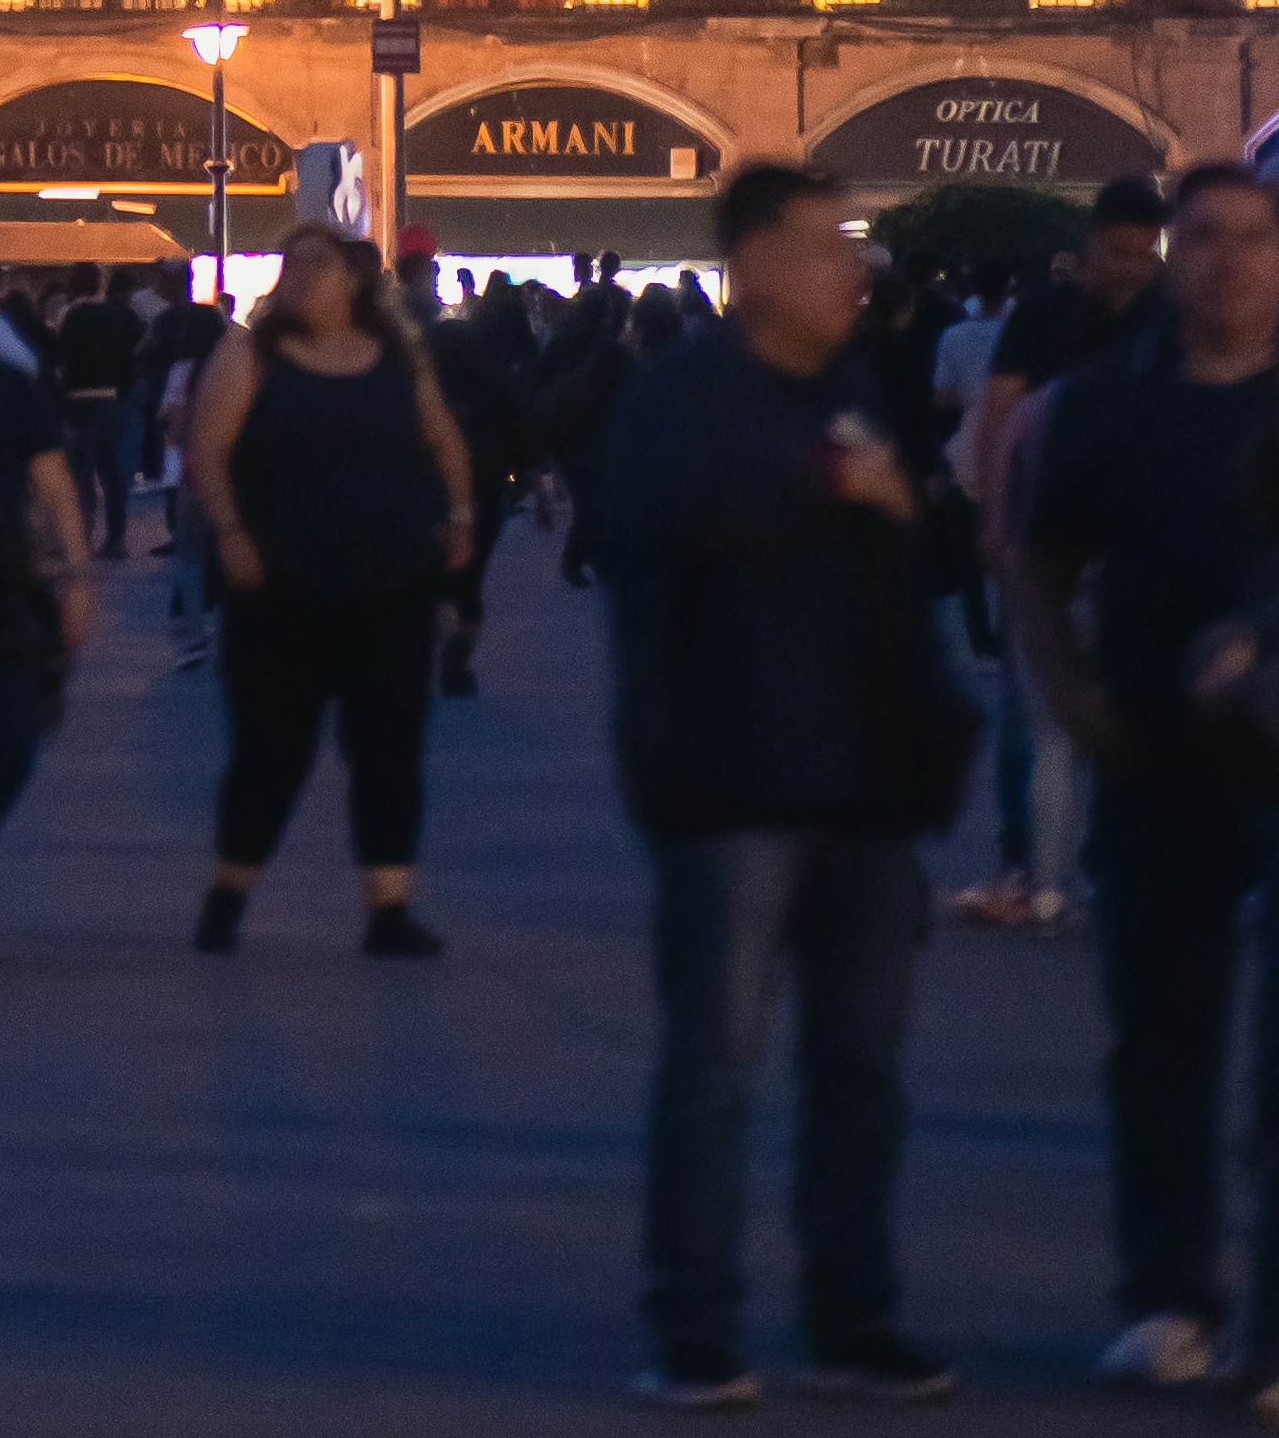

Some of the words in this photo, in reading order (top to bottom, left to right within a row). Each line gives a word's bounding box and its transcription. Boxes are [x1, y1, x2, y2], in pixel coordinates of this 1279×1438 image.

[935, 99, 1040, 124] OPTICA
[470, 119, 636, 156] ARMANI
[103, 141, 141, 170] DE
[160, 140, 283, 170] MEICO
[914, 138, 1063, 174] TURATI
